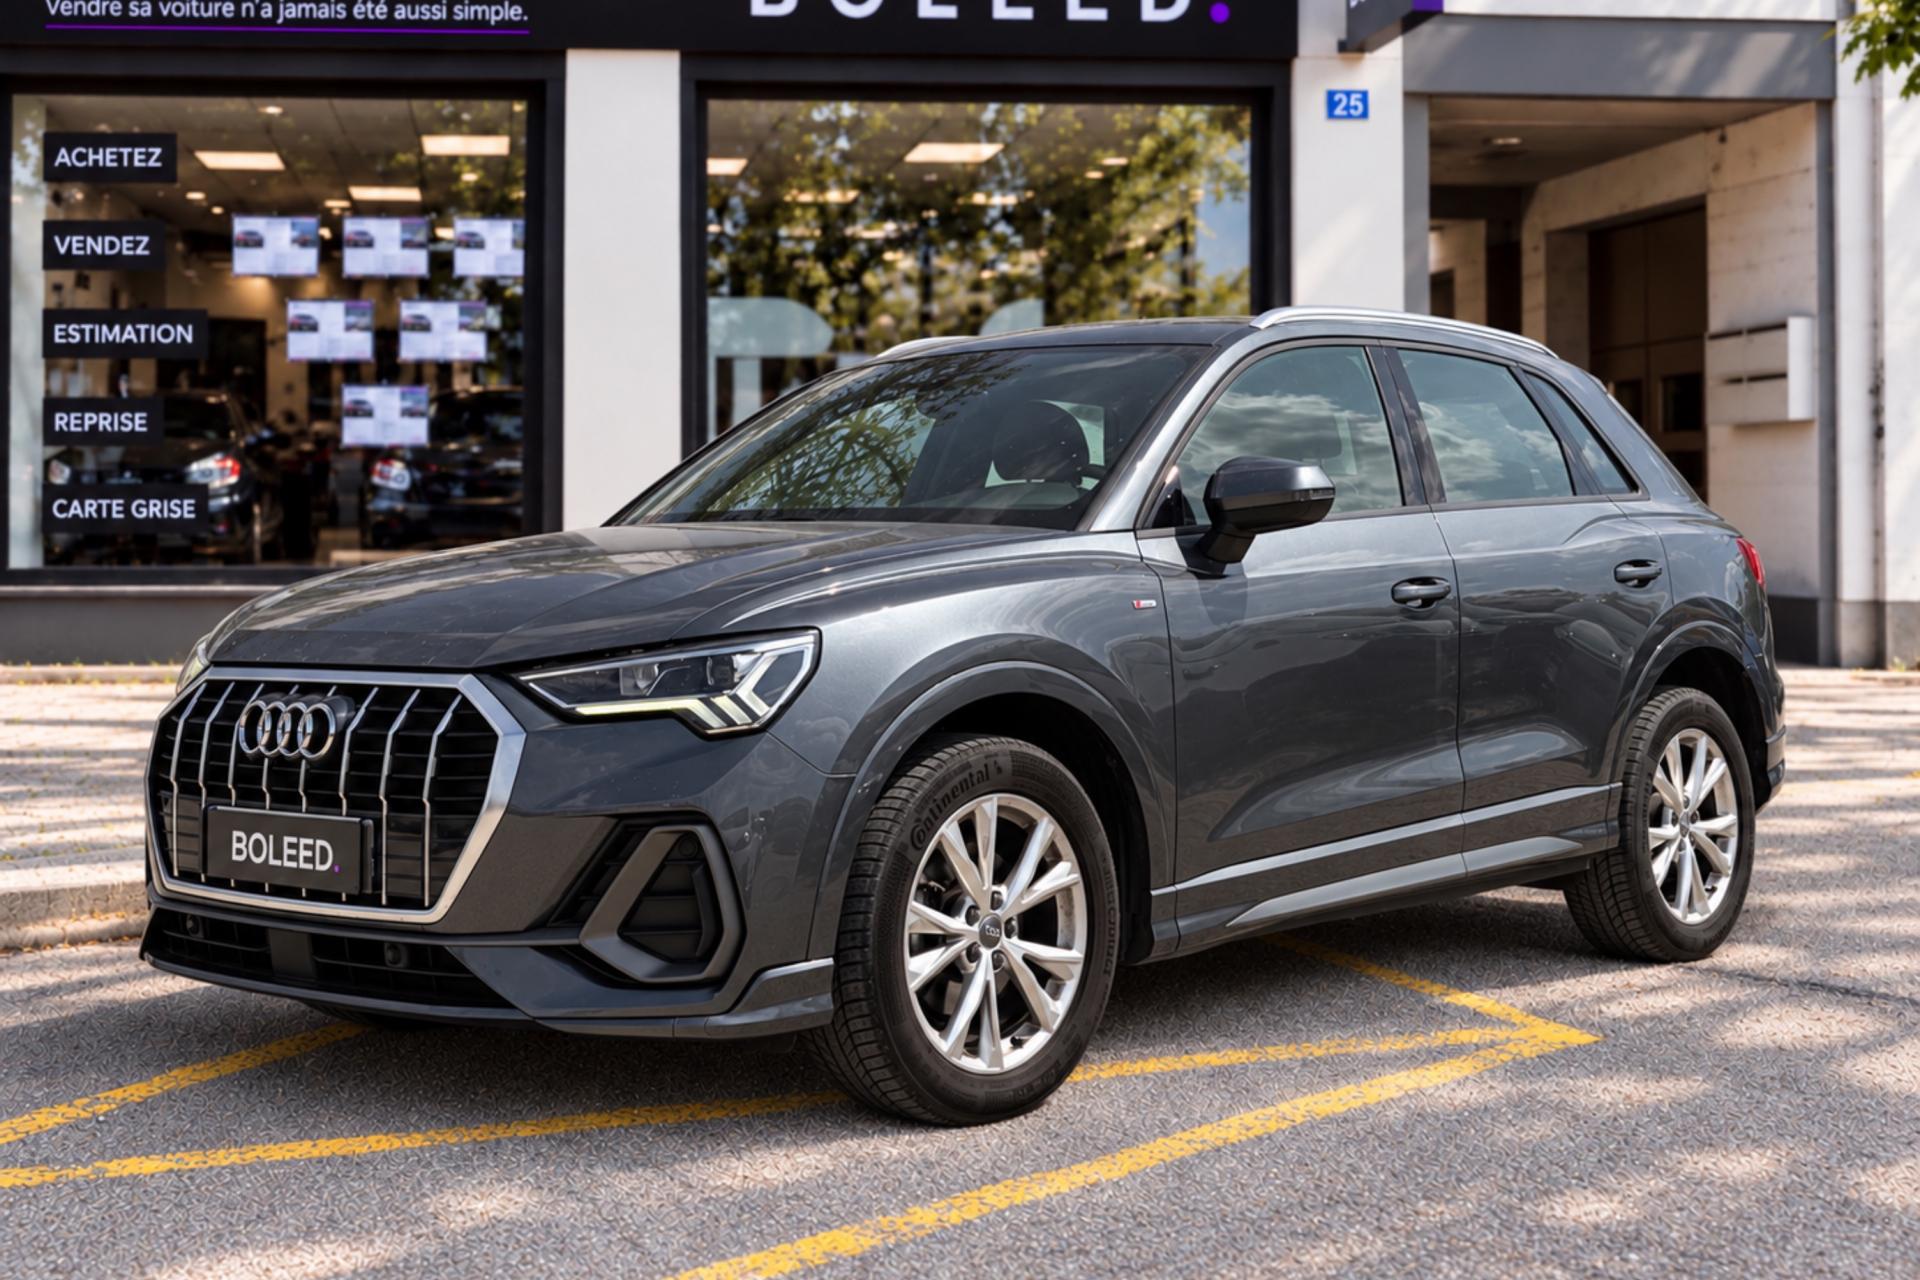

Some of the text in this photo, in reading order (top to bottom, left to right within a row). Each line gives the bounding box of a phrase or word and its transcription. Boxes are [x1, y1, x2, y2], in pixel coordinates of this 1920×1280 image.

[46, 0, 528, 26] Vendre sa voiture n'a jamais été aussi simple.
[1333, 93, 1364, 116] 25
[54, 147, 162, 167] ACHETEZ
[54, 235, 150, 255] VENDEZ
[54, 323, 193, 344] ESTIMATION
[54, 412, 148, 432] REPRISE
[52, 498, 196, 519] CARTE GRISE
